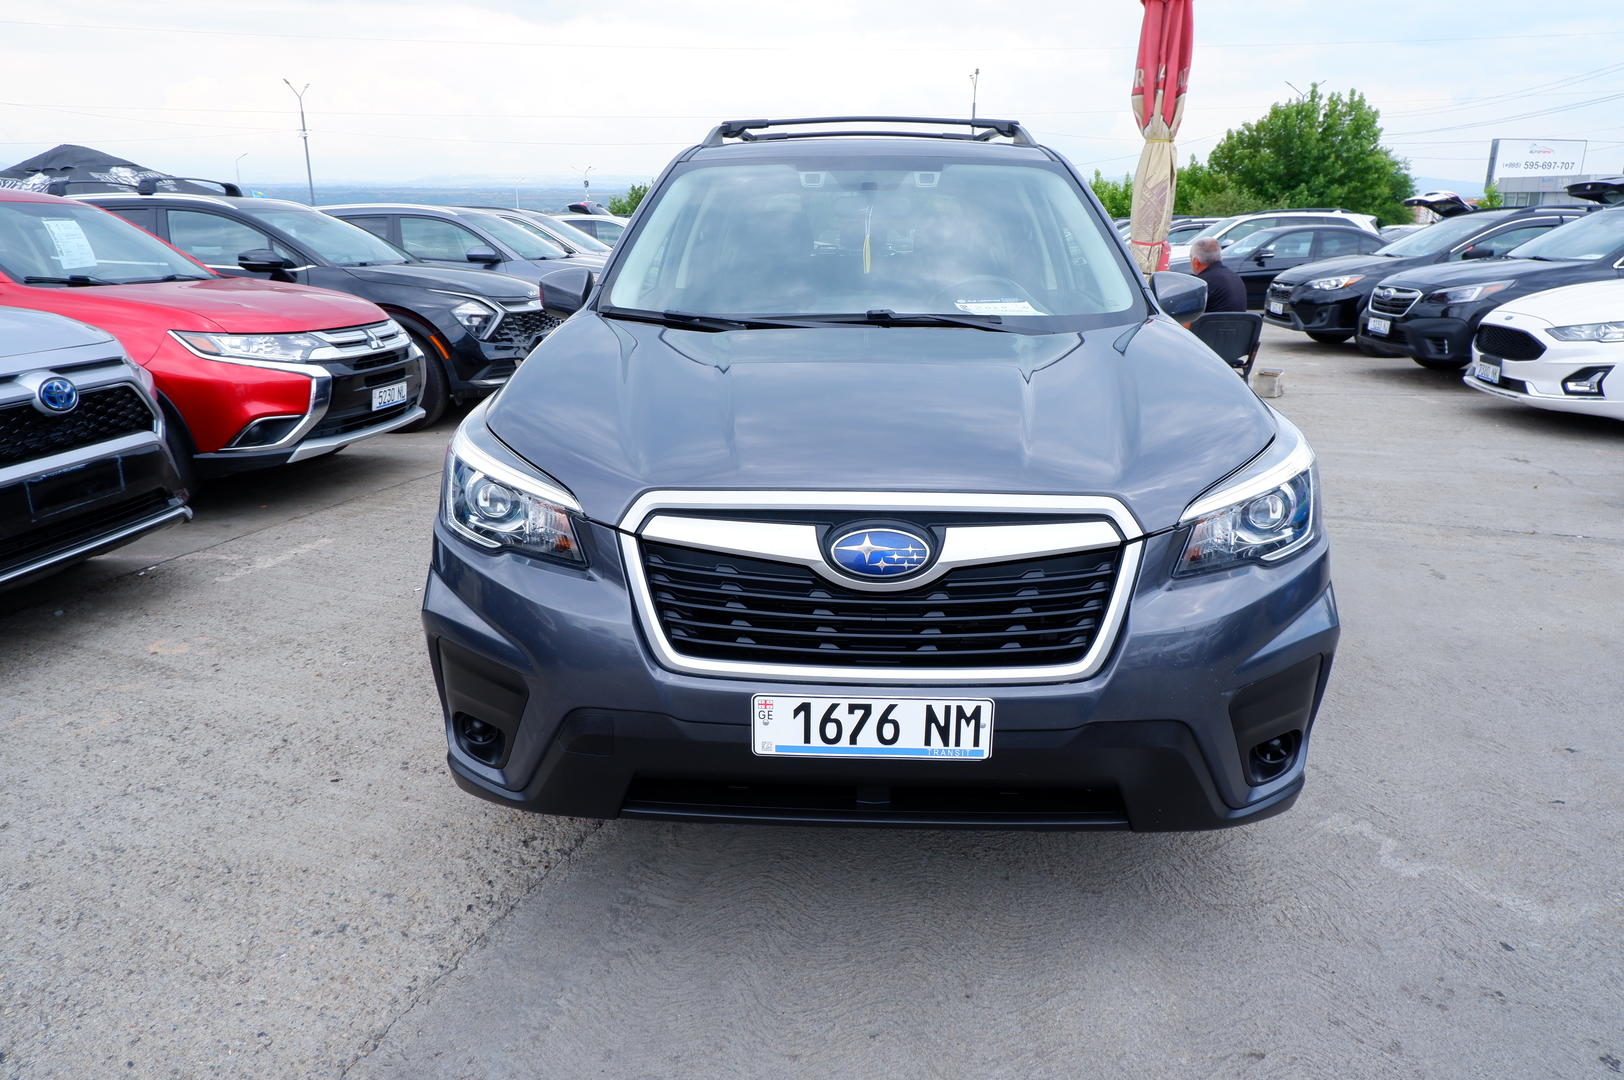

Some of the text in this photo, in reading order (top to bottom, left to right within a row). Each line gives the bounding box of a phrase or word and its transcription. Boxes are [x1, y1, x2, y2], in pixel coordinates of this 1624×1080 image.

[1523, 161, 1575, 170] 595-697-707
[758, 710, 773, 720] GE
[793, 701, 982, 748] 1676 NM
[927, 748, 971, 757] TRANSIT
